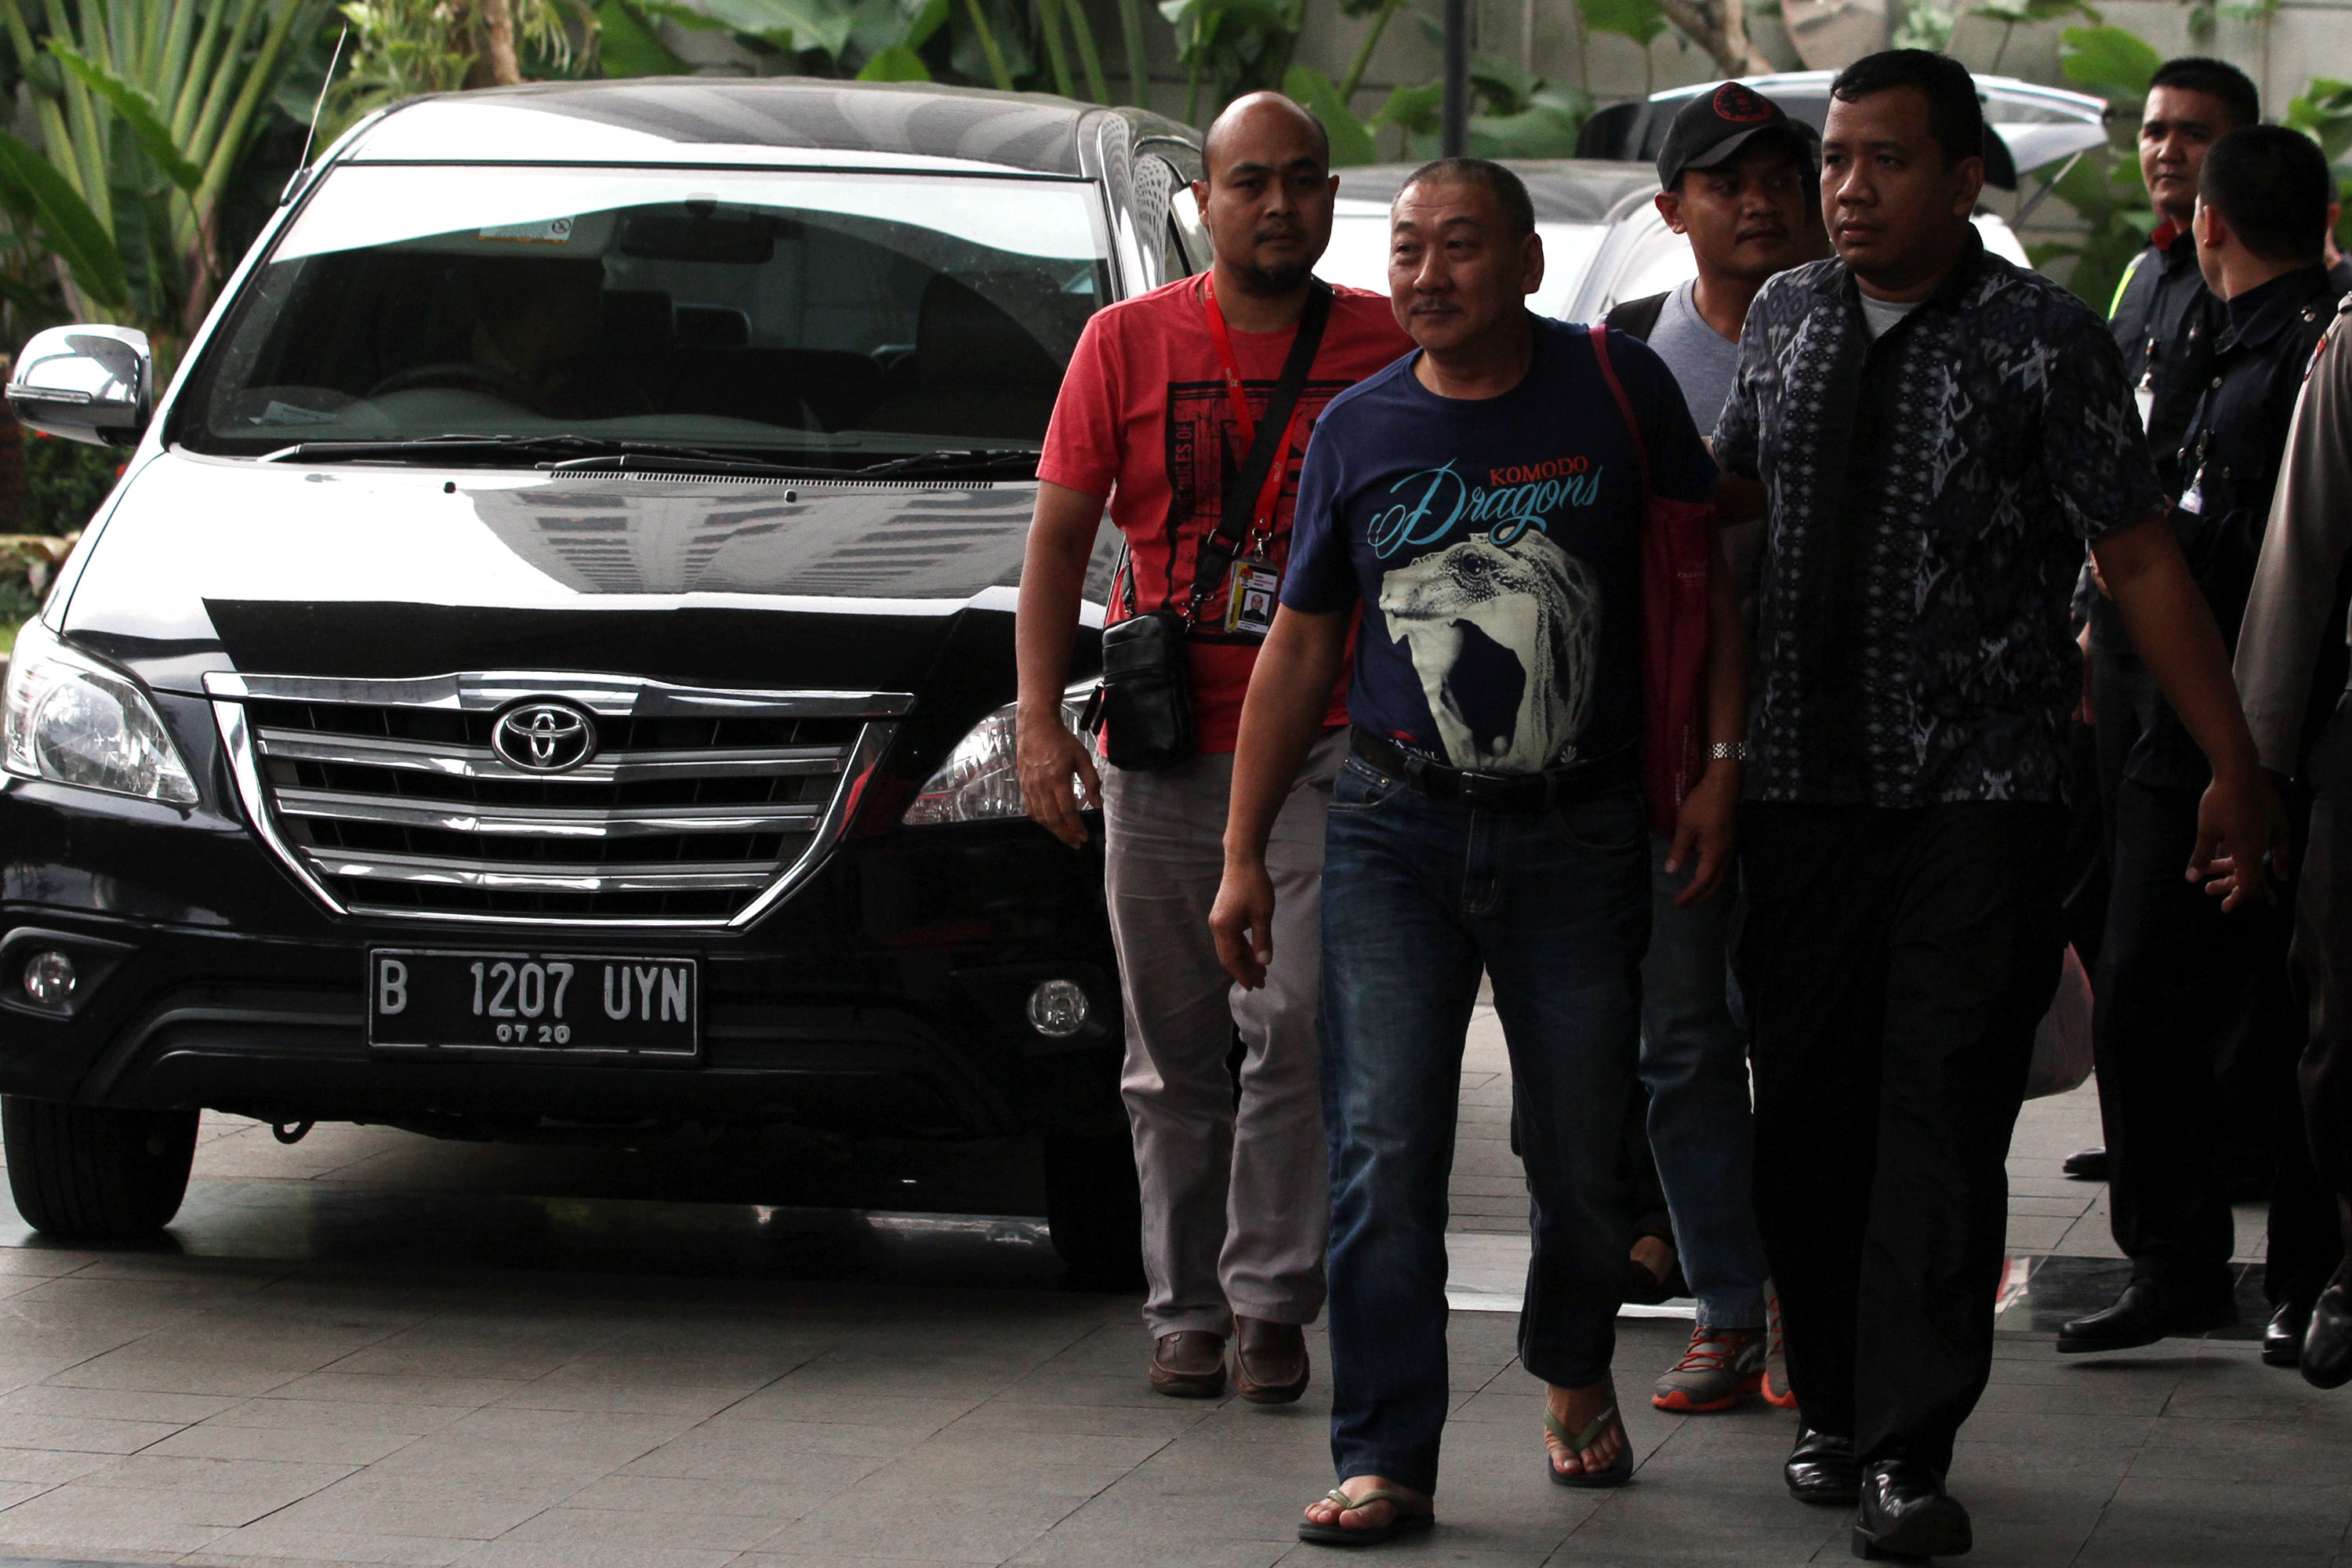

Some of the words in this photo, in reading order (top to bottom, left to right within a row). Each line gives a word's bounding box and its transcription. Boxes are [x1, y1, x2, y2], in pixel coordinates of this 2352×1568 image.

[1174, 423, 1192, 440] OF
[1490, 456, 1588, 486] KOMODO
[1367, 457, 1602, 559] Dragons
[379, 959, 408, 1015] B
[470, 962, 575, 1018] 1207
[604, 966, 687, 1022] UYN
[495, 1024, 528, 1043] 07
[538, 1025, 571, 1044] 20
